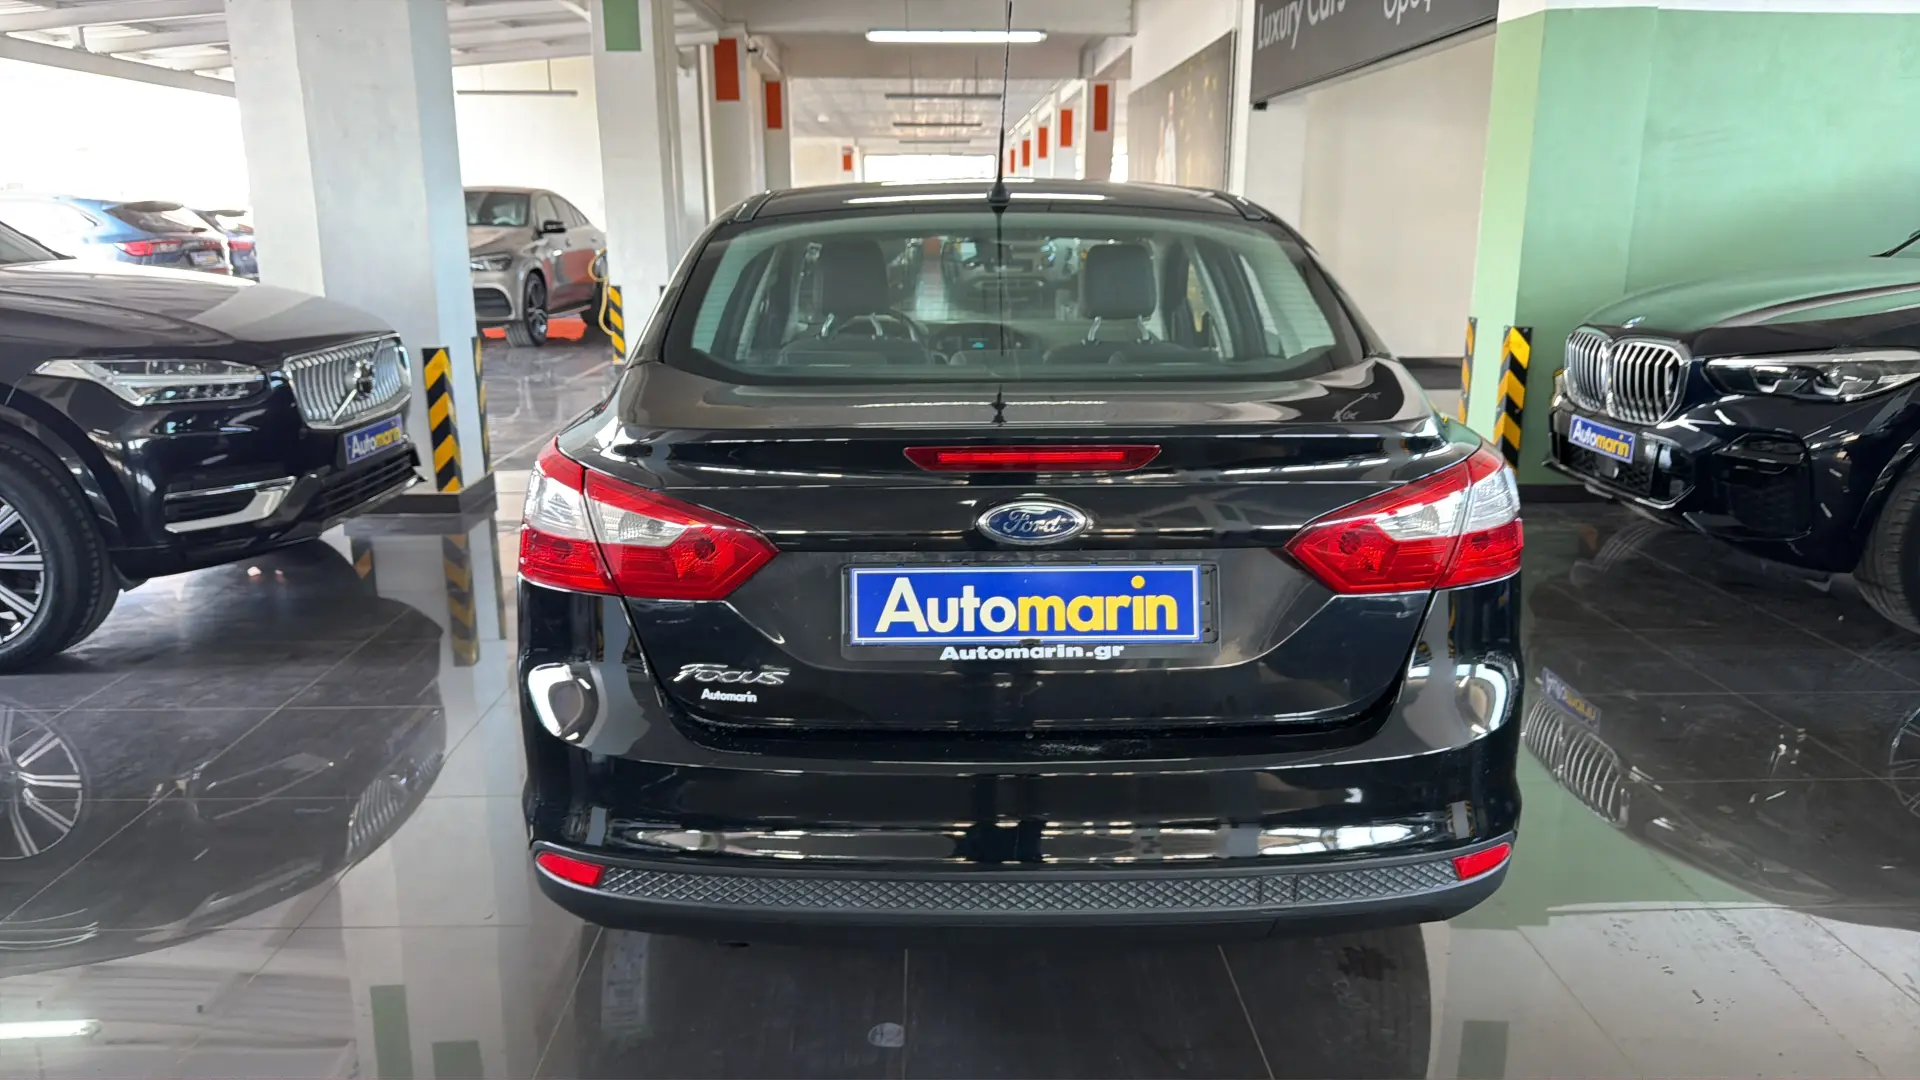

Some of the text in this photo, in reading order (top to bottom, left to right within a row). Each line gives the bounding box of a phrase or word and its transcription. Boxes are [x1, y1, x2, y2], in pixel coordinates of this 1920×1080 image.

[1257, 0, 1305, 51] Luxury
[1572, 420, 1629, 458] Automarin
[1002, 509, 1063, 533] Ford
[875, 575, 1178, 633] Automarin
[939, 644, 1125, 662] Automarin.gr
[700, 688, 758, 703] Automarin
